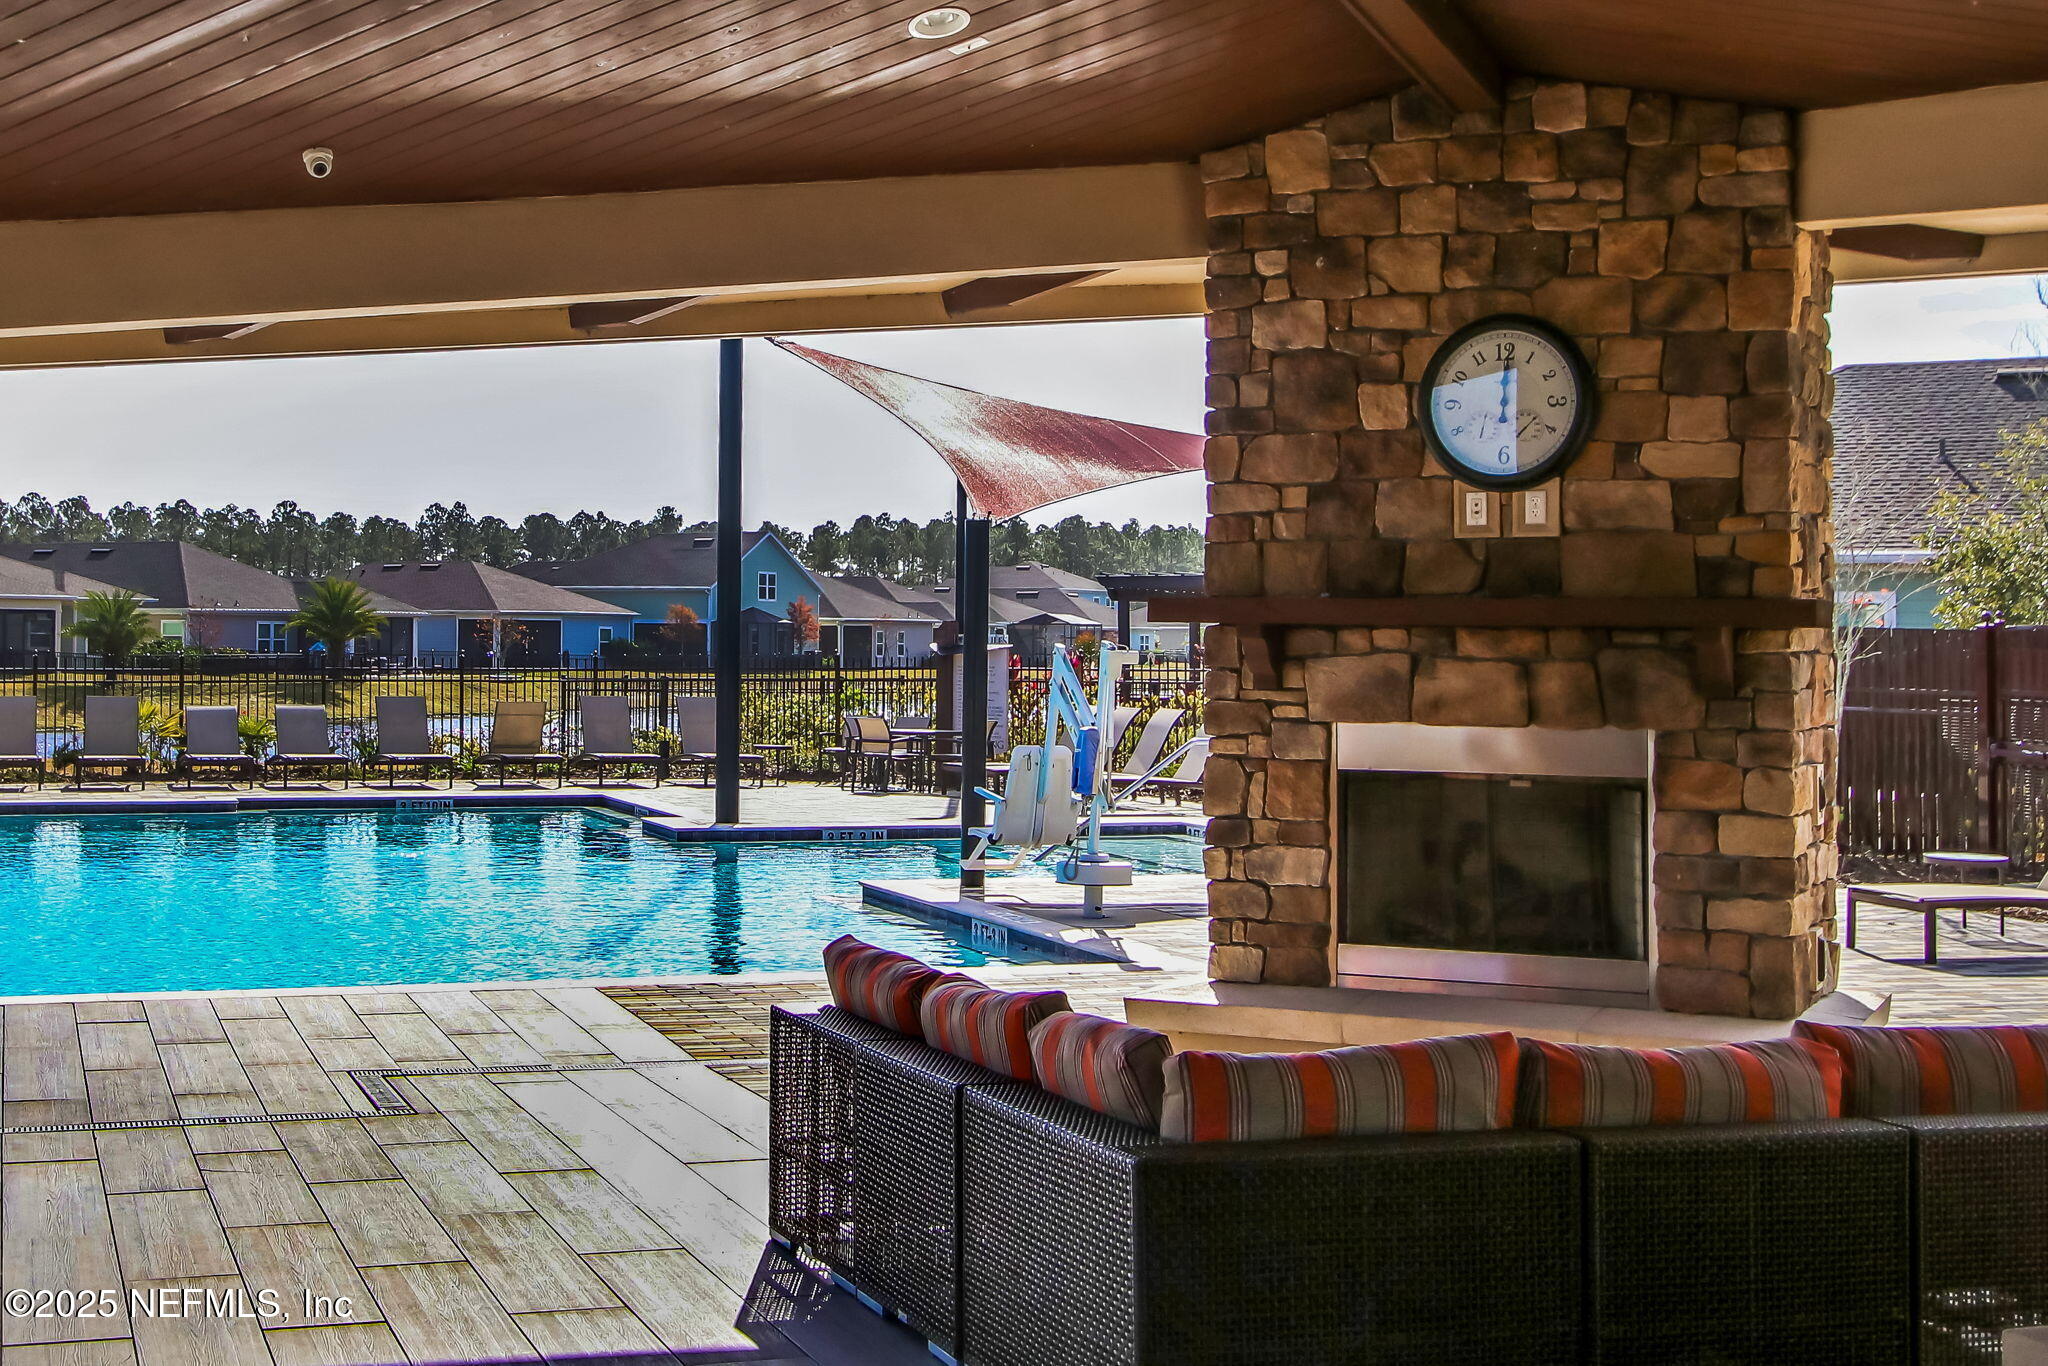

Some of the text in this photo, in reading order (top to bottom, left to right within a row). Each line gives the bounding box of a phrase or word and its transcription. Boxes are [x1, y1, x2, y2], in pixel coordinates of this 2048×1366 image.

[1495, 342, 1515, 361] 12
[1525, 351, 1536, 365] 1
[1471, 350, 1488, 367] 11
[1451, 370, 1468, 387] 10
[1542, 369, 1557, 382] 2
[1444, 399, 1462, 411] 9
[1547, 395, 1567, 408] 3
[1451, 425, 1464, 437] 8
[1544, 423, 1557, 435] 4
[1498, 445, 1510, 465] 6
